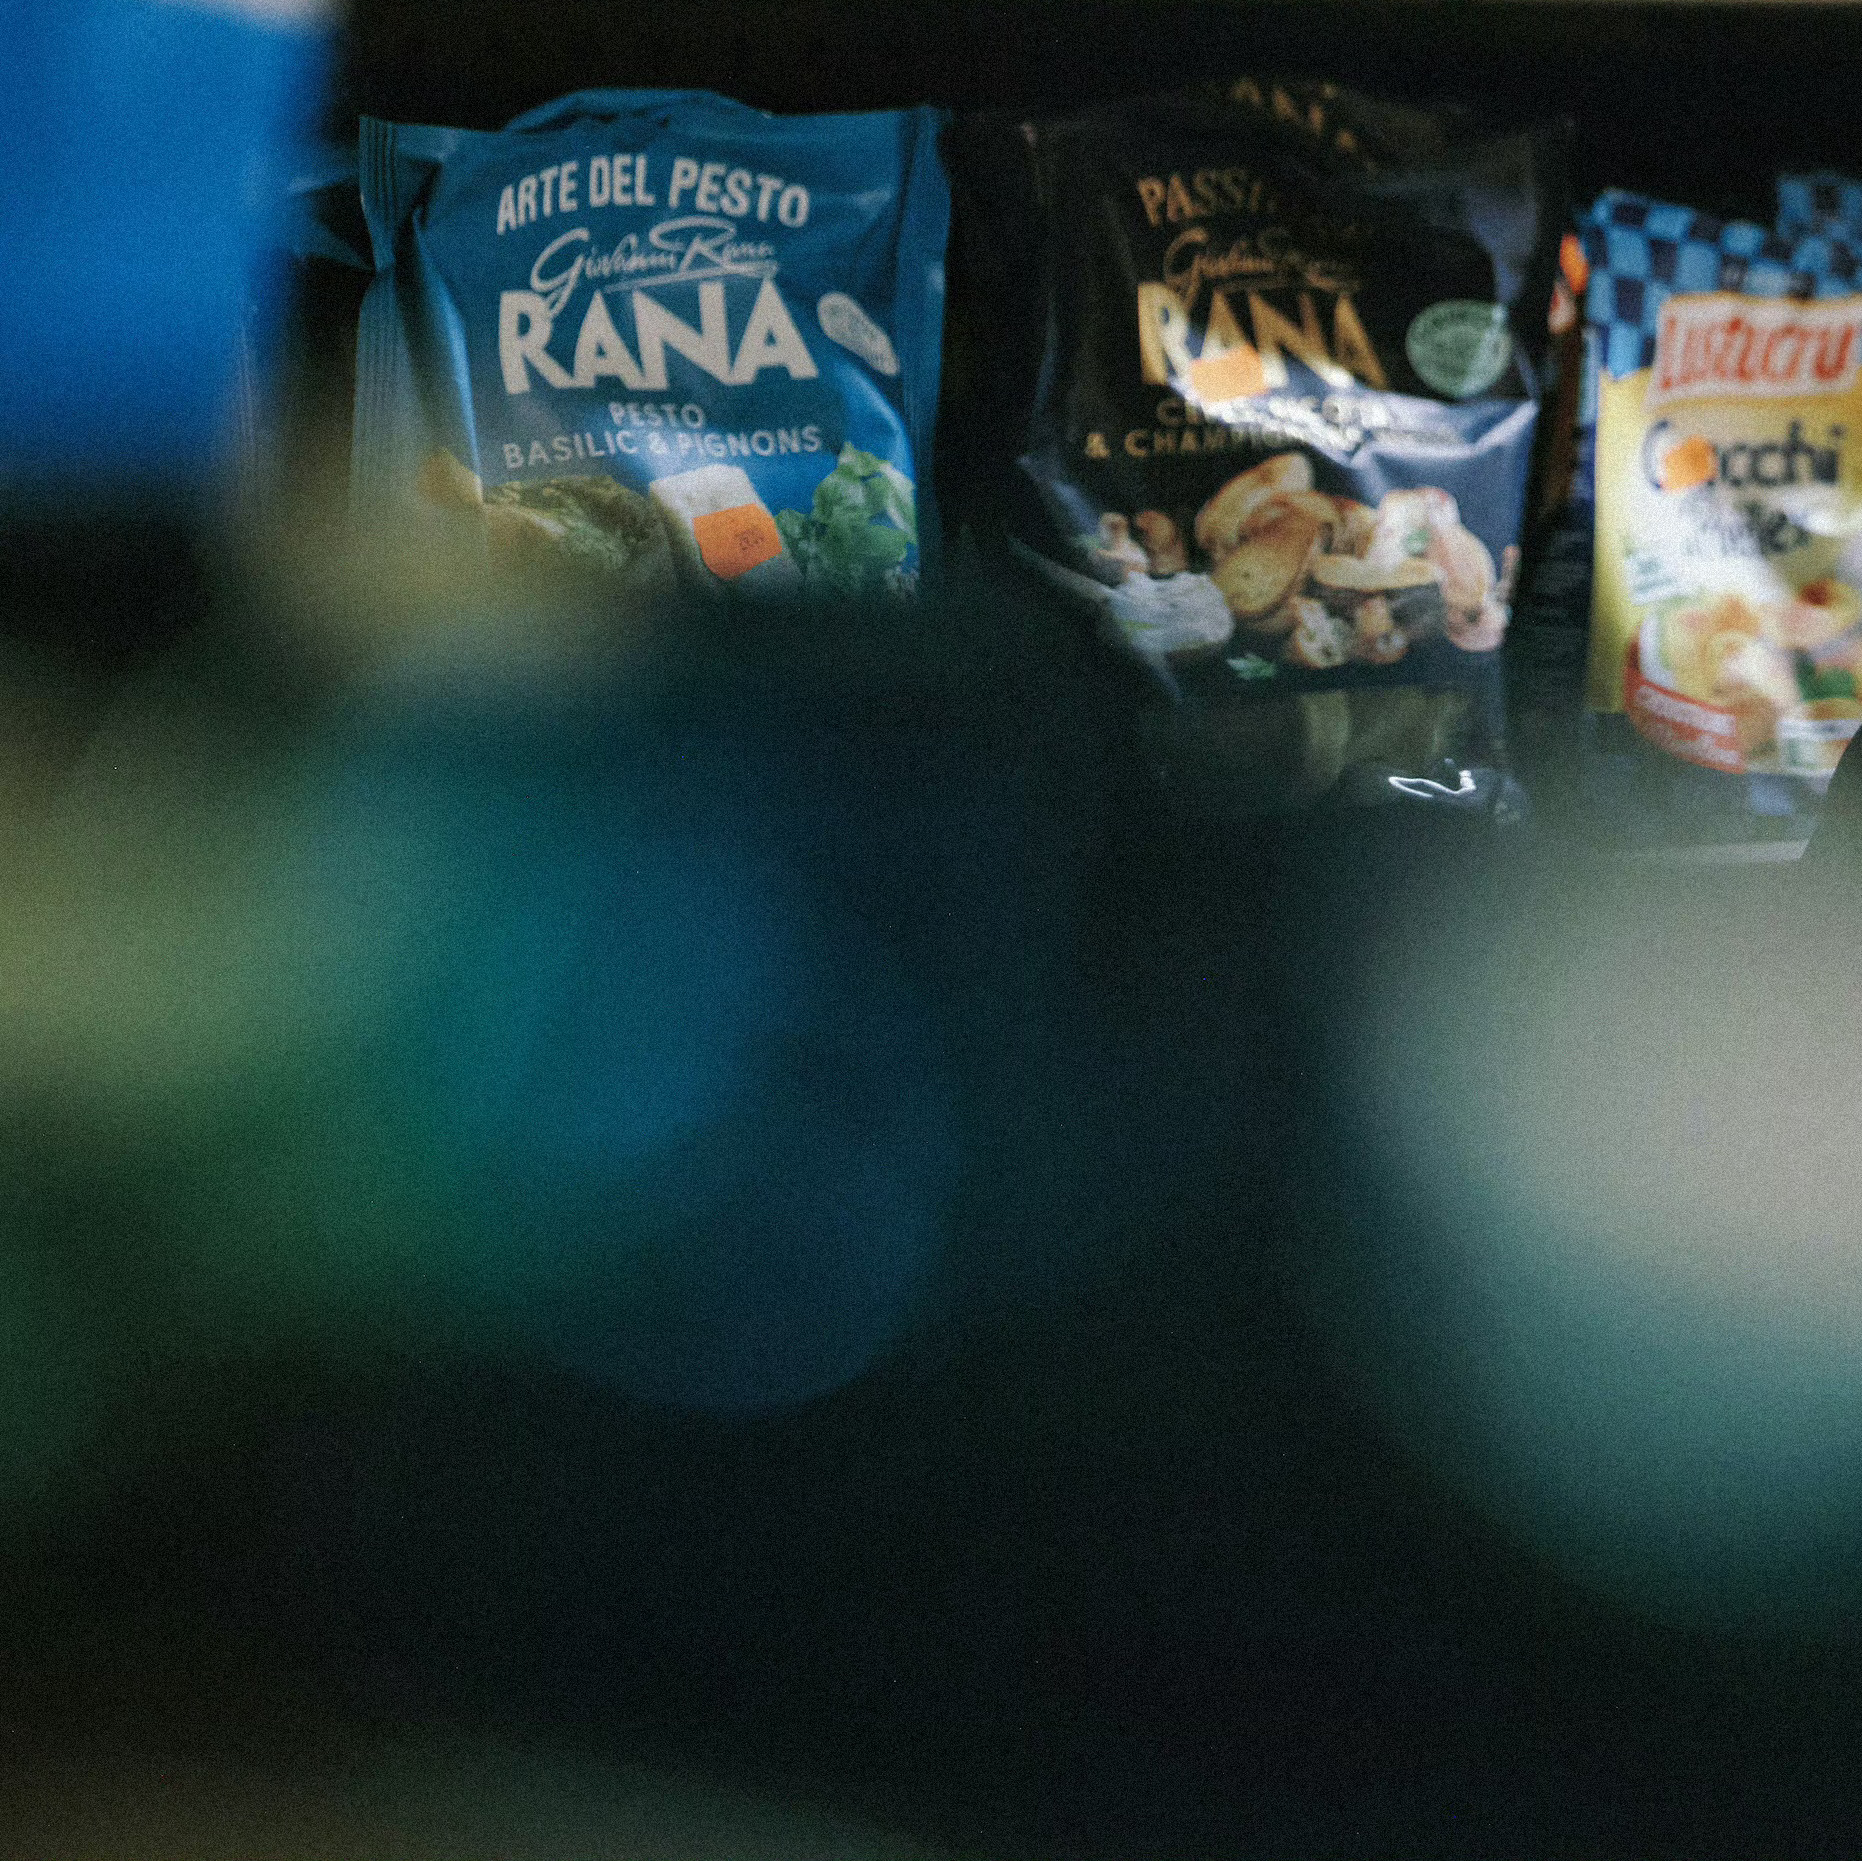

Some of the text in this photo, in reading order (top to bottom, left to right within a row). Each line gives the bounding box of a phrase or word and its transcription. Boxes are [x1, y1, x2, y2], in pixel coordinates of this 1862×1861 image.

[496, 152, 810, 236] ARTE DEL PESTO
[498, 278, 819, 395] RANA
[609, 401, 706, 429] PESTO
[503, 430, 639, 470] BASILIC
[674, 425, 823, 459] PIGNONS
